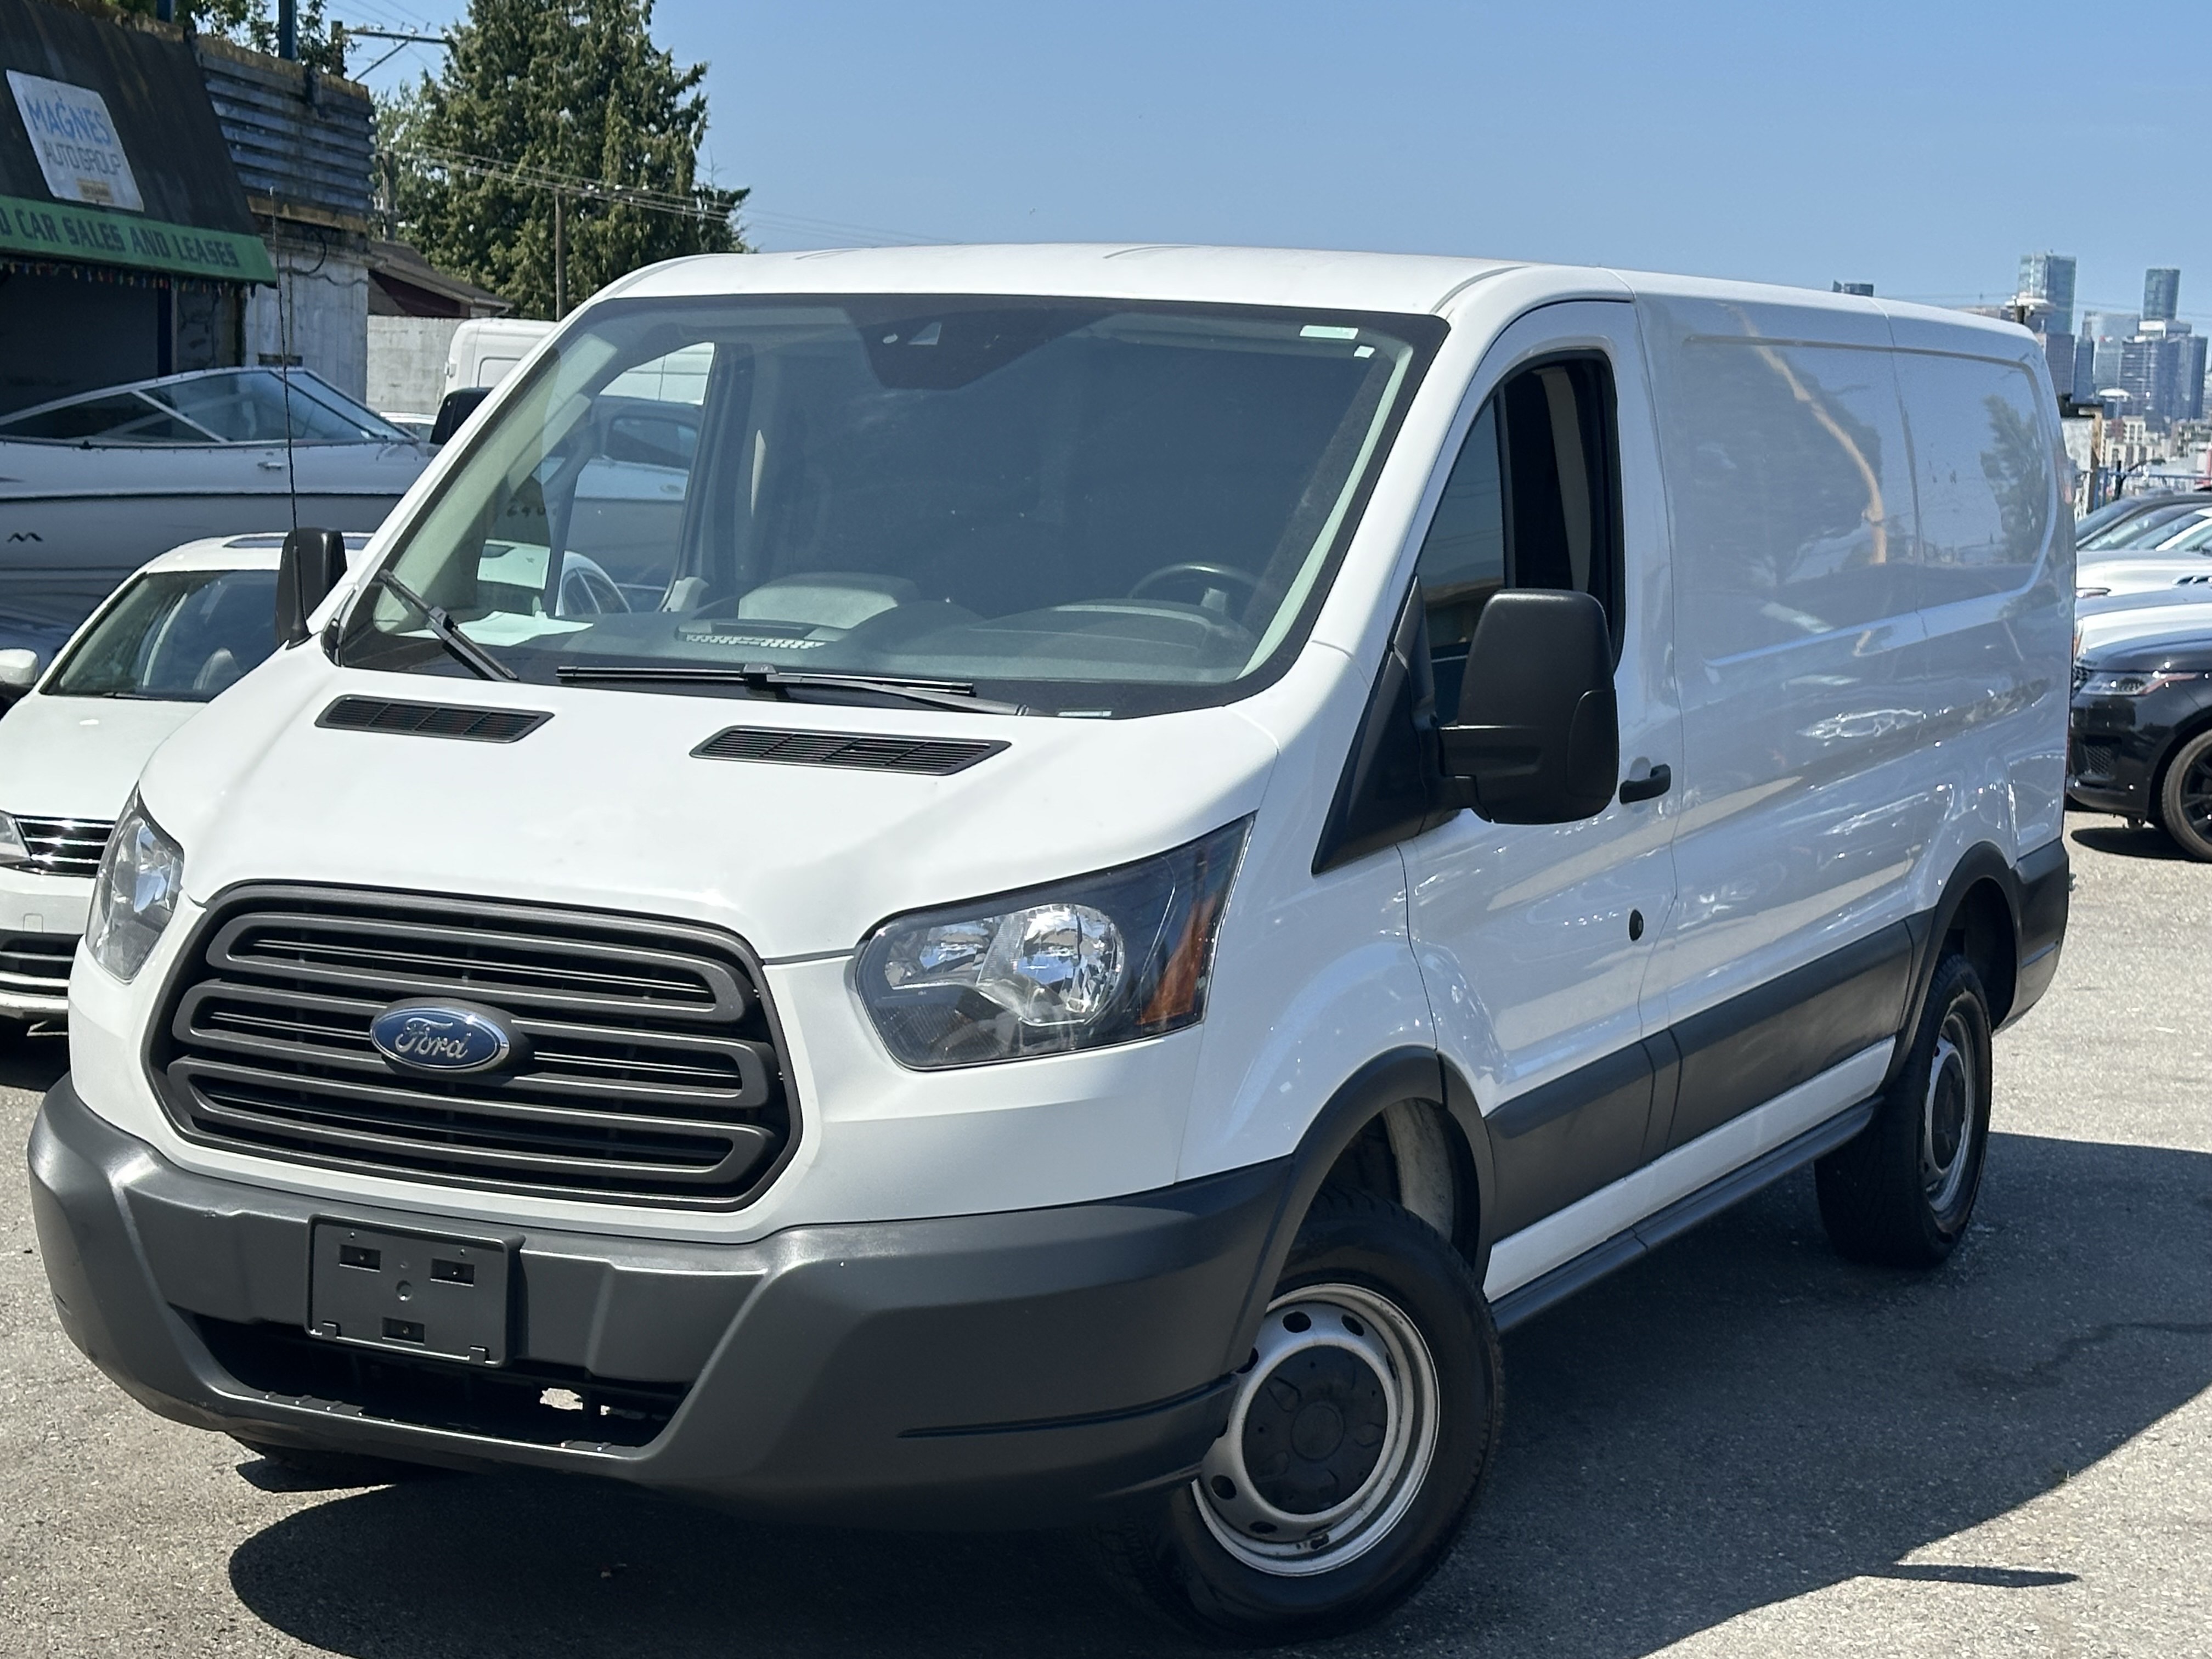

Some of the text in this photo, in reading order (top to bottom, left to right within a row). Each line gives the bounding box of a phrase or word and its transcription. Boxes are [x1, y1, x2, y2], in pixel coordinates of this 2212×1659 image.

[24, 95, 112, 146] MAGNES
[14, 209, 61, 243] CAR
[61, 217, 126, 252] SALES
[129, 227, 171, 258] AND
[171, 234, 239, 267] LEASES
[395, 1017, 472, 1059] Ford
